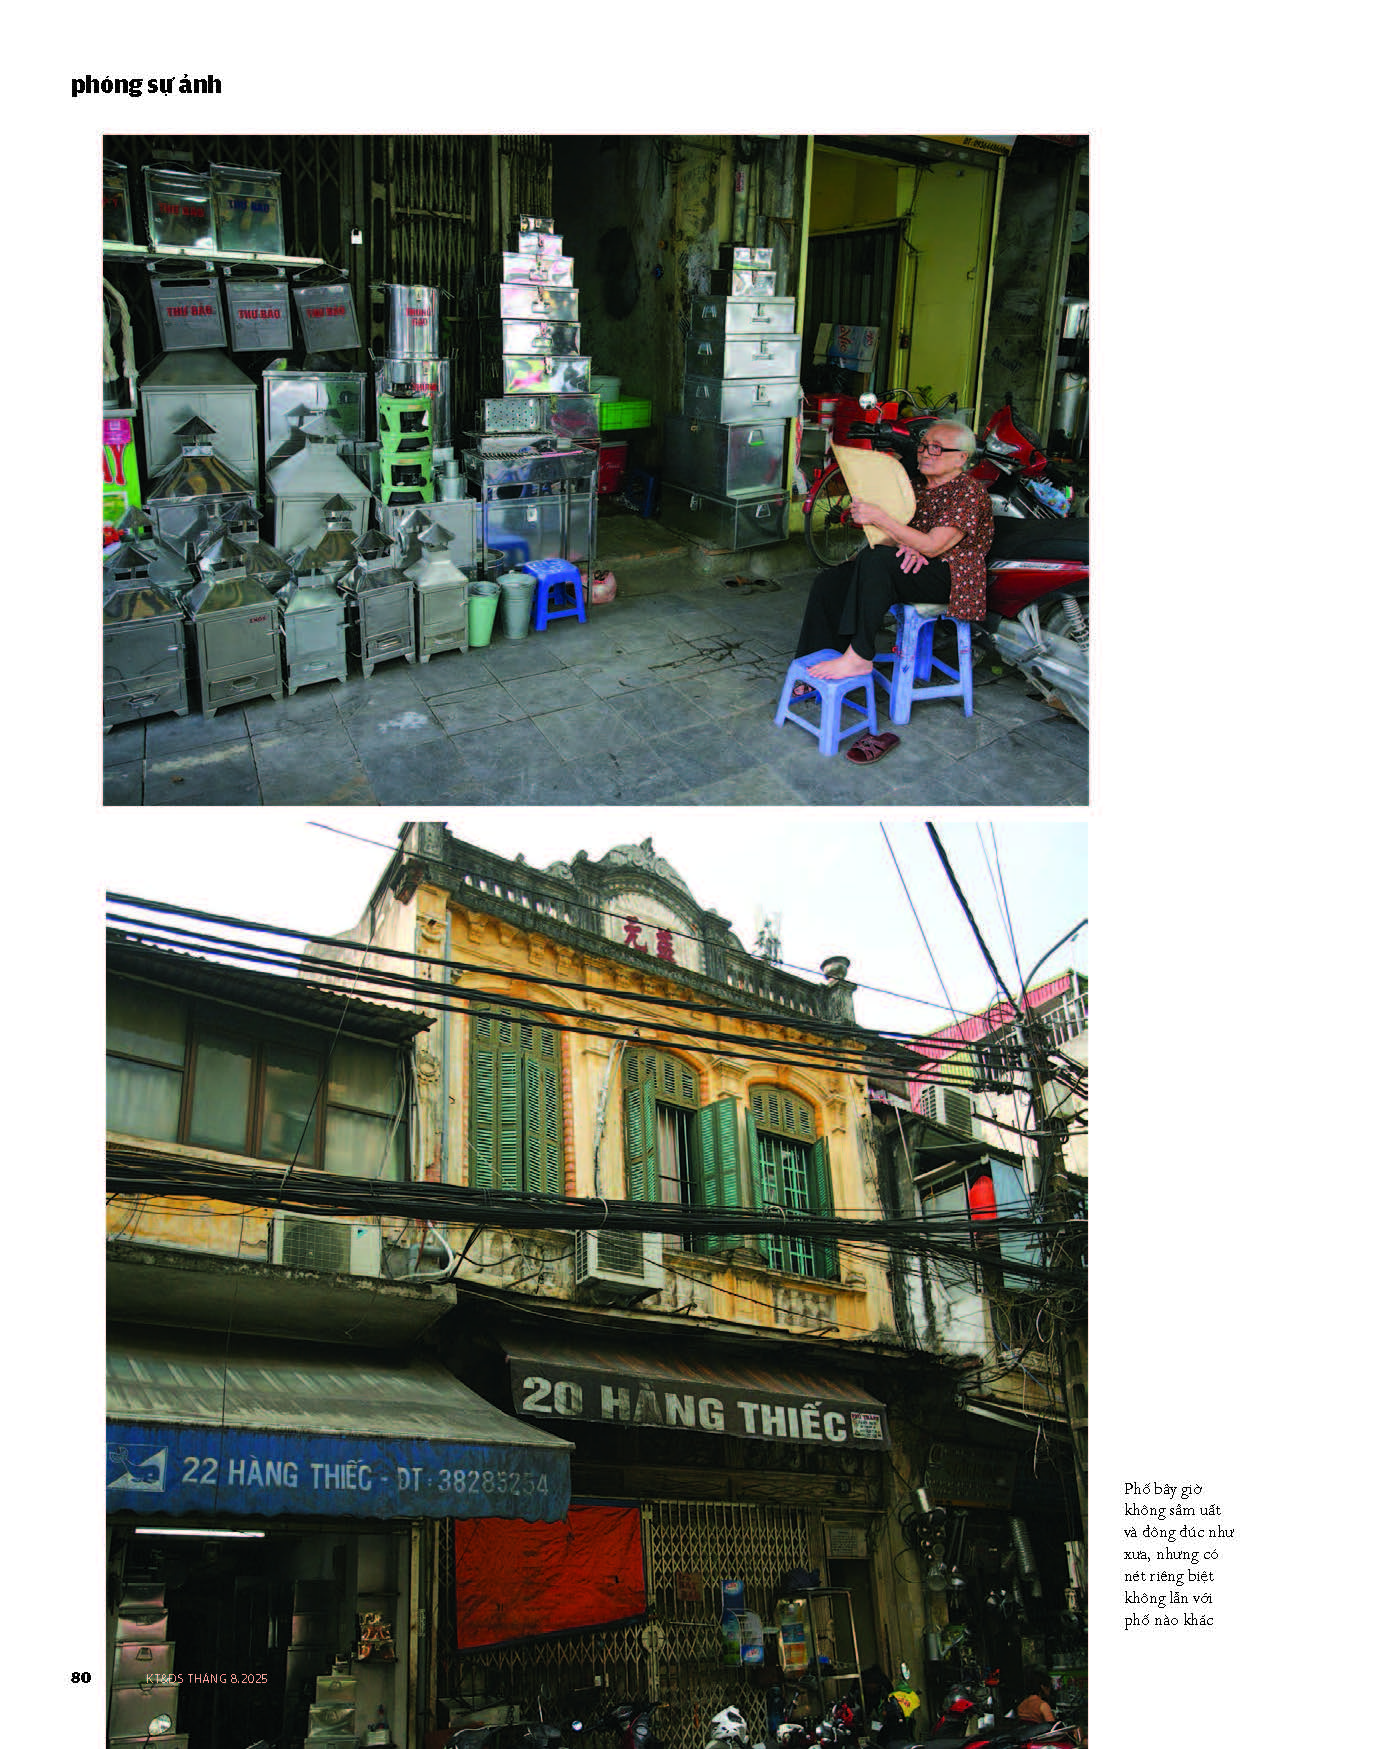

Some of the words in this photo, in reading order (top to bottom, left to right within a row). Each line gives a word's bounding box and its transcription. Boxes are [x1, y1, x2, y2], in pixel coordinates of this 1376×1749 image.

[522, 1376, 583, 1416] 20
[600, 1383, 725, 1431] HÀNG
[736, 1401, 847, 1442] THIẾC
[182, 1456, 218, 1485] 22
[228, 1454, 298, 1488] HÀNG
[311, 1459, 373, 1491] THIẾC
